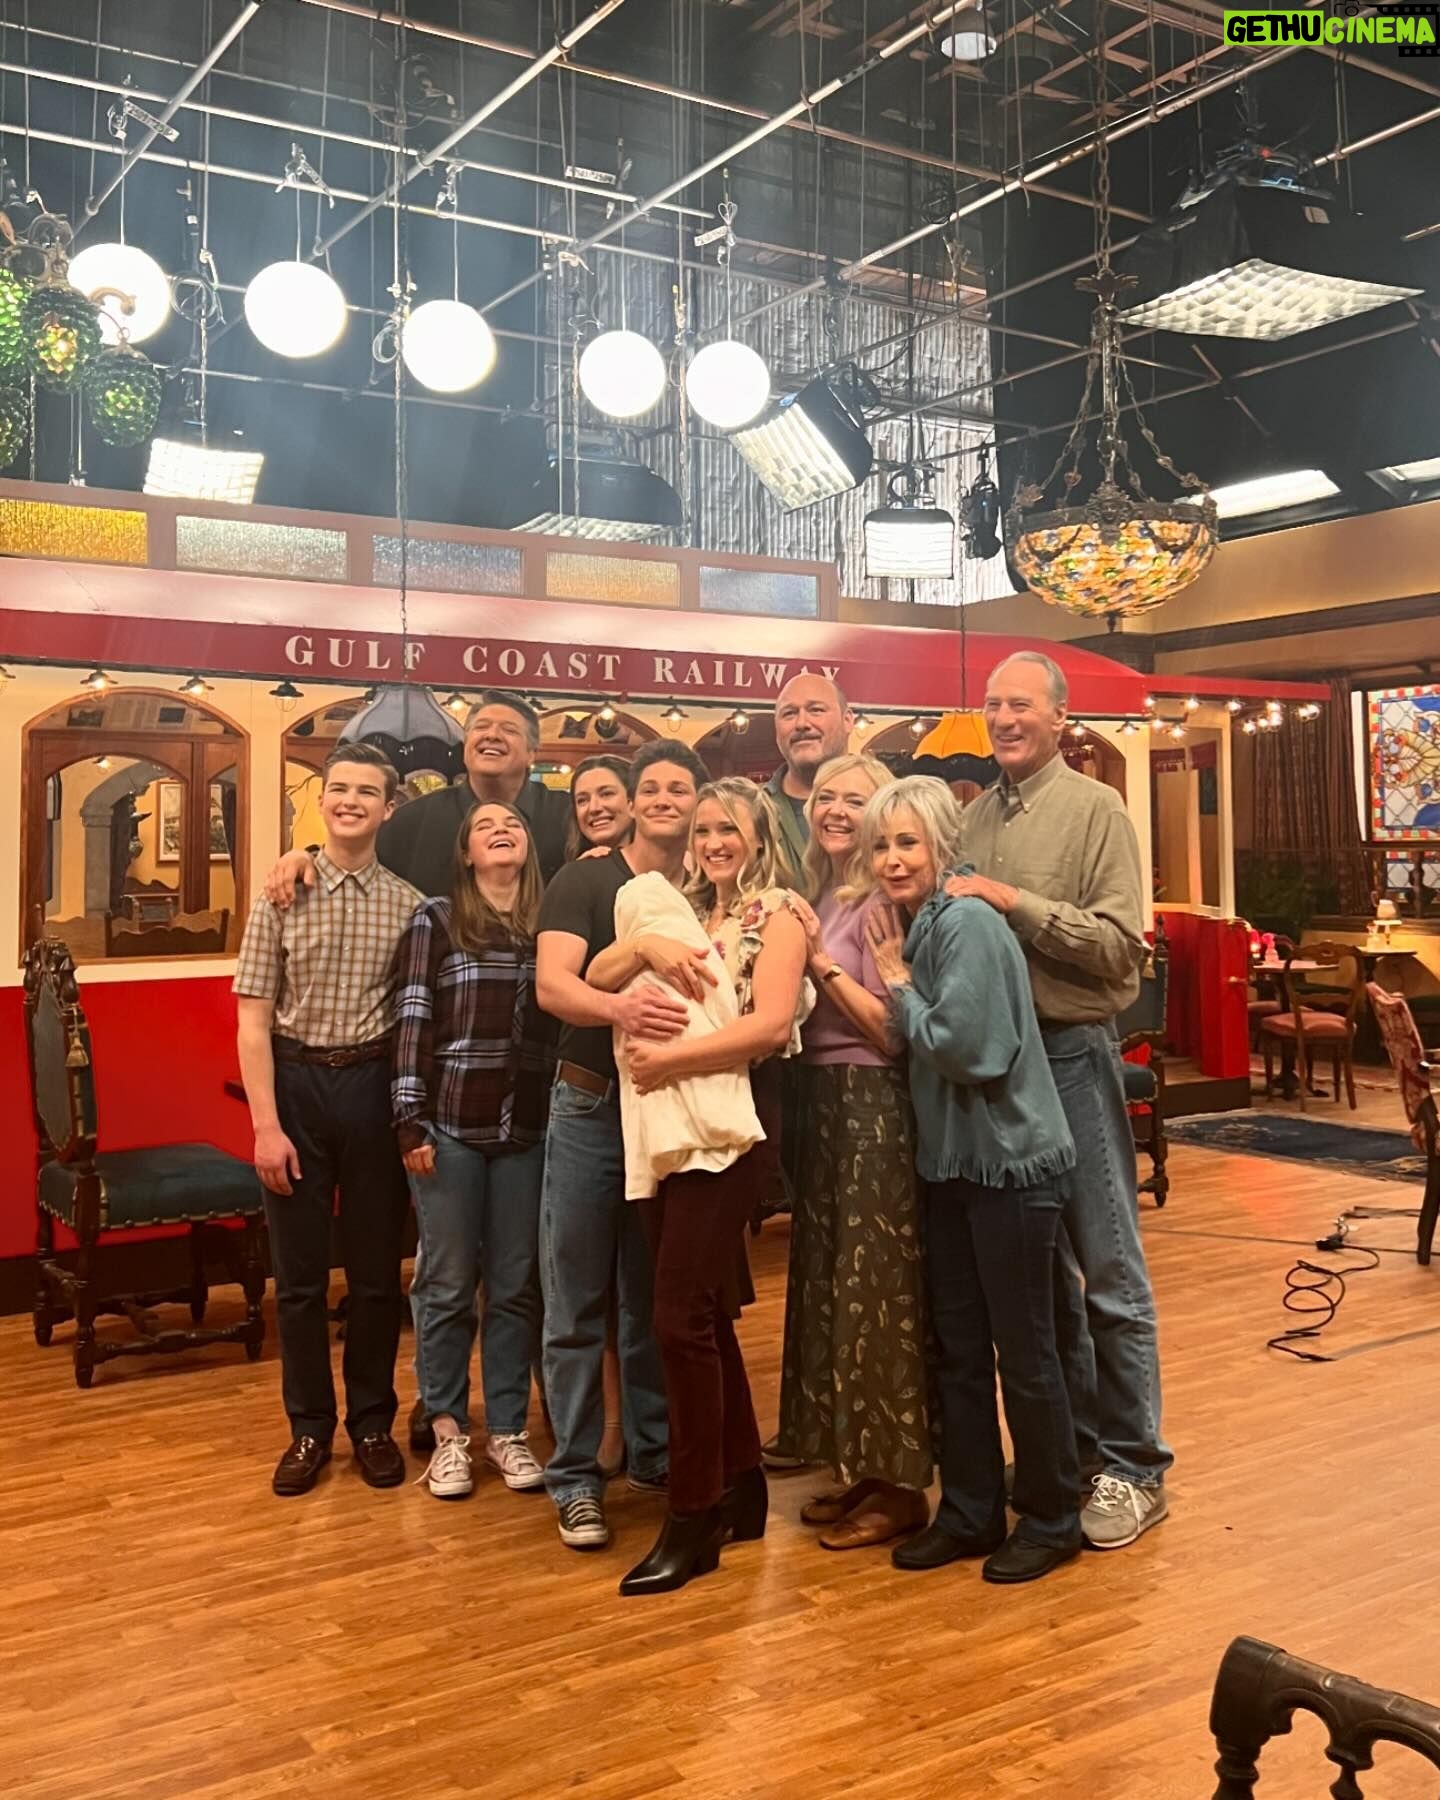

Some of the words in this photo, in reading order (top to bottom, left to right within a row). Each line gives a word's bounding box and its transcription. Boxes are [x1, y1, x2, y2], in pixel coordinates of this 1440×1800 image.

[284, 635, 426, 671] GULF
[463, 644, 621, 681] COAST
[653, 656, 840, 689] RAILWY
